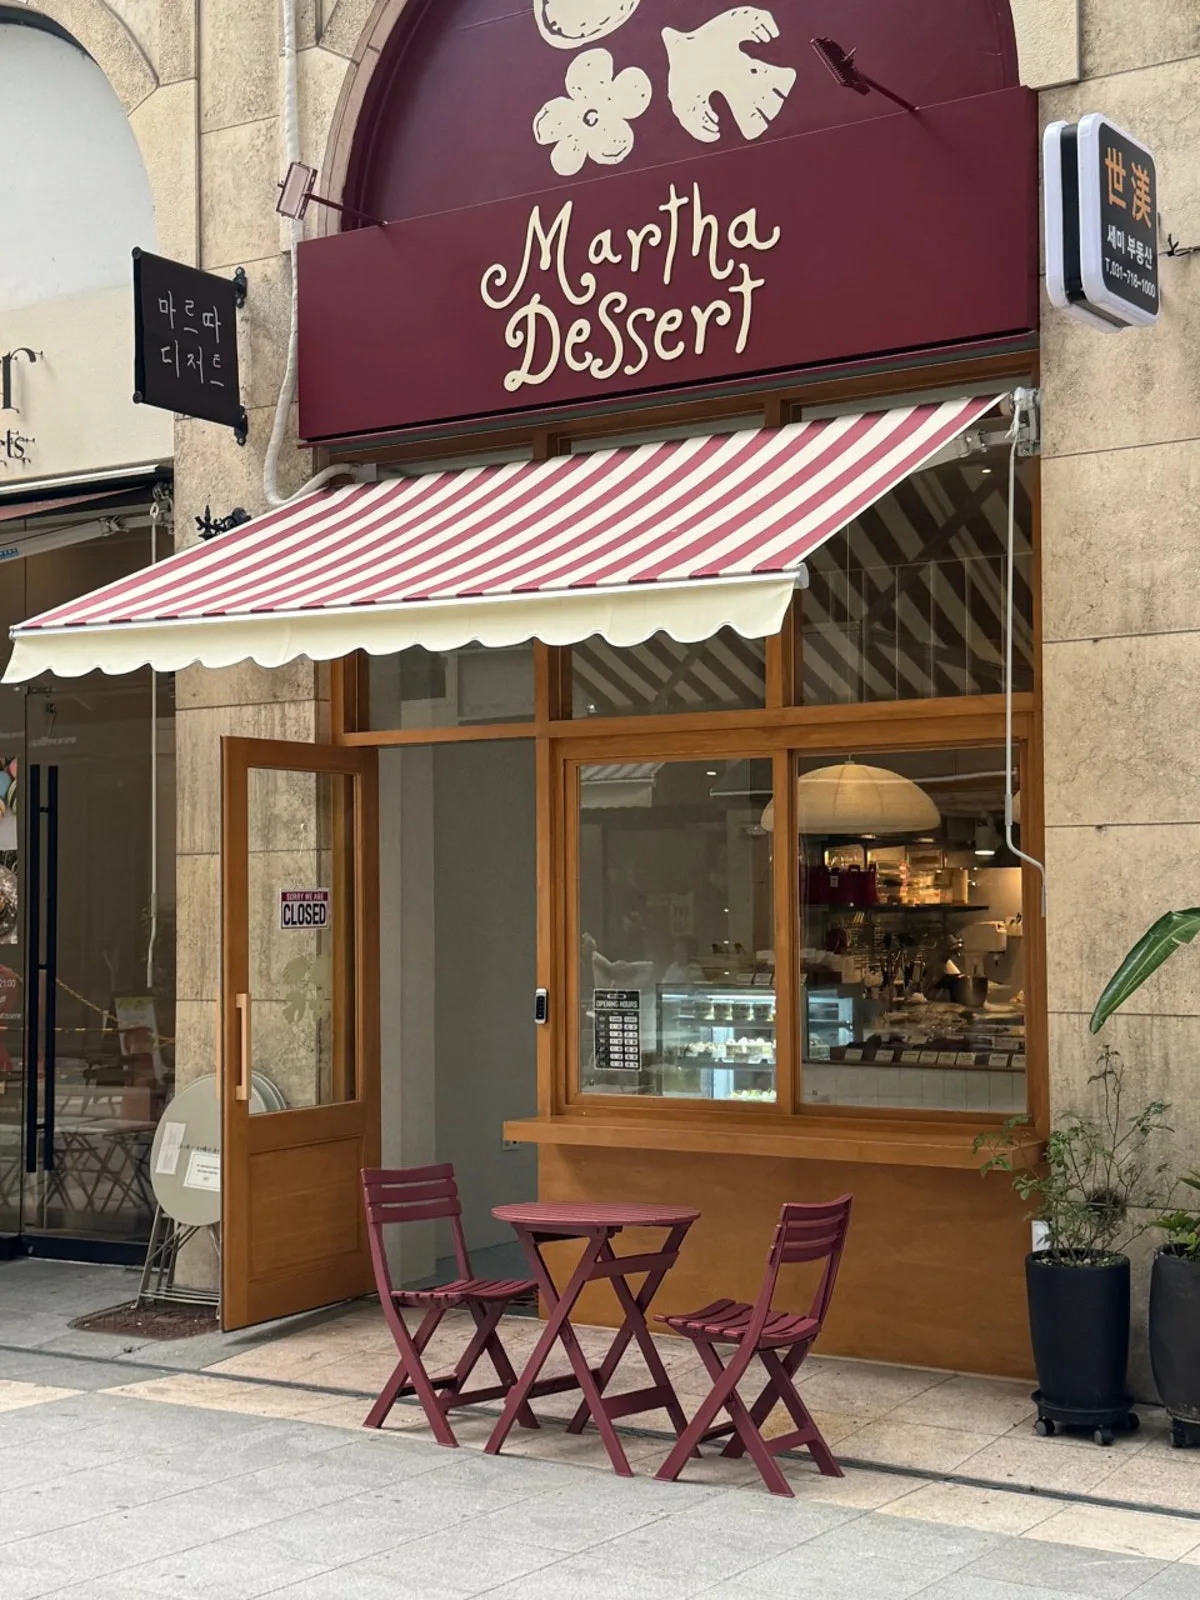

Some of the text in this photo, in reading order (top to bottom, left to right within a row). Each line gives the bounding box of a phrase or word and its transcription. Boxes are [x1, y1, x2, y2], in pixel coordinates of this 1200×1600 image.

[480, 182, 780, 309] Martha
[1107, 224, 1153, 270] 세미 부동산
[158, 290, 221, 344] 마르따
[503, 263, 765, 392] Dessert
[161, 339, 224, 387] 디저트
[283, 903, 326, 925] CLOSED
[286, 893, 304, 901] SORRY
[596, 1000, 638, 1008] OPENING HOURS
